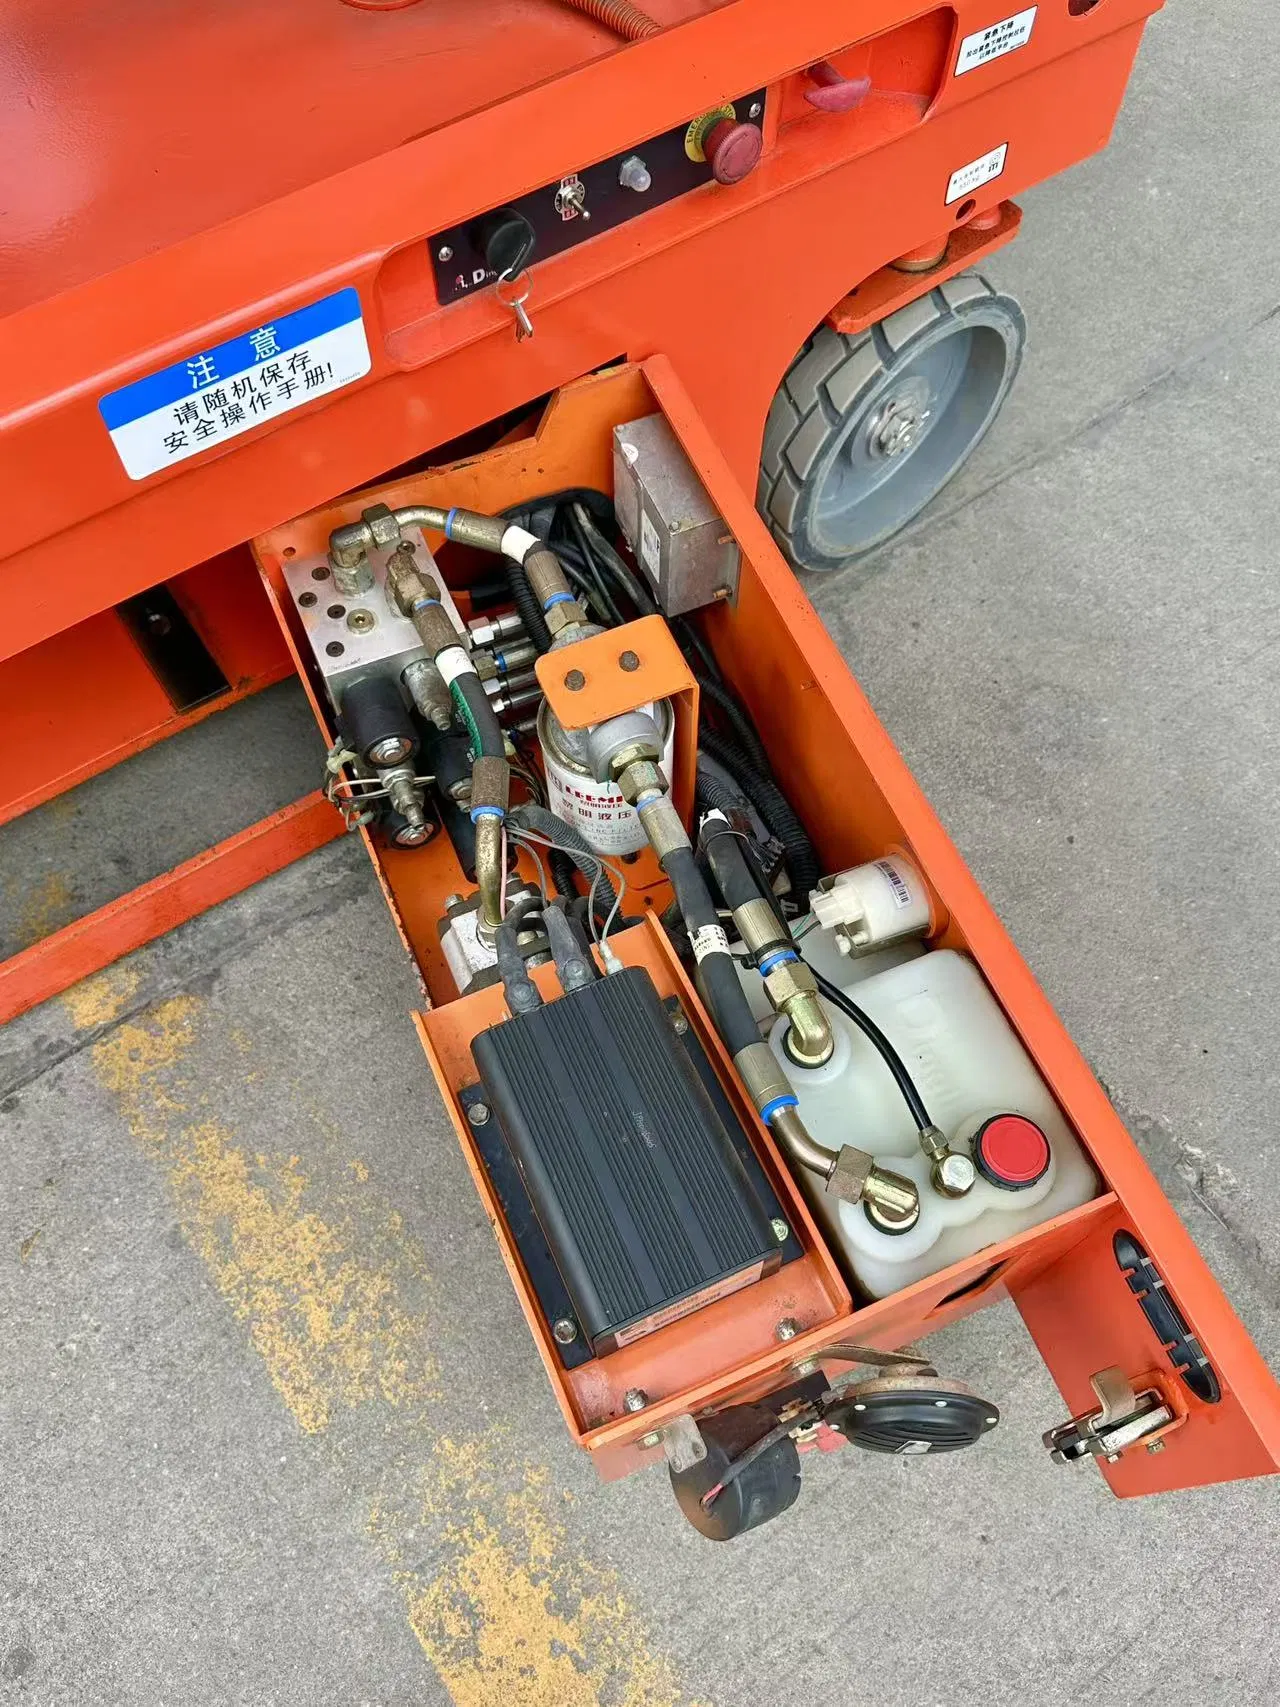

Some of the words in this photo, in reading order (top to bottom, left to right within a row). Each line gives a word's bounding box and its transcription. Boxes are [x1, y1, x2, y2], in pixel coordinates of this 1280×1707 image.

[163, 362, 335, 454] 安全操作手册!
[173, 350, 311, 426] 请随机保存
